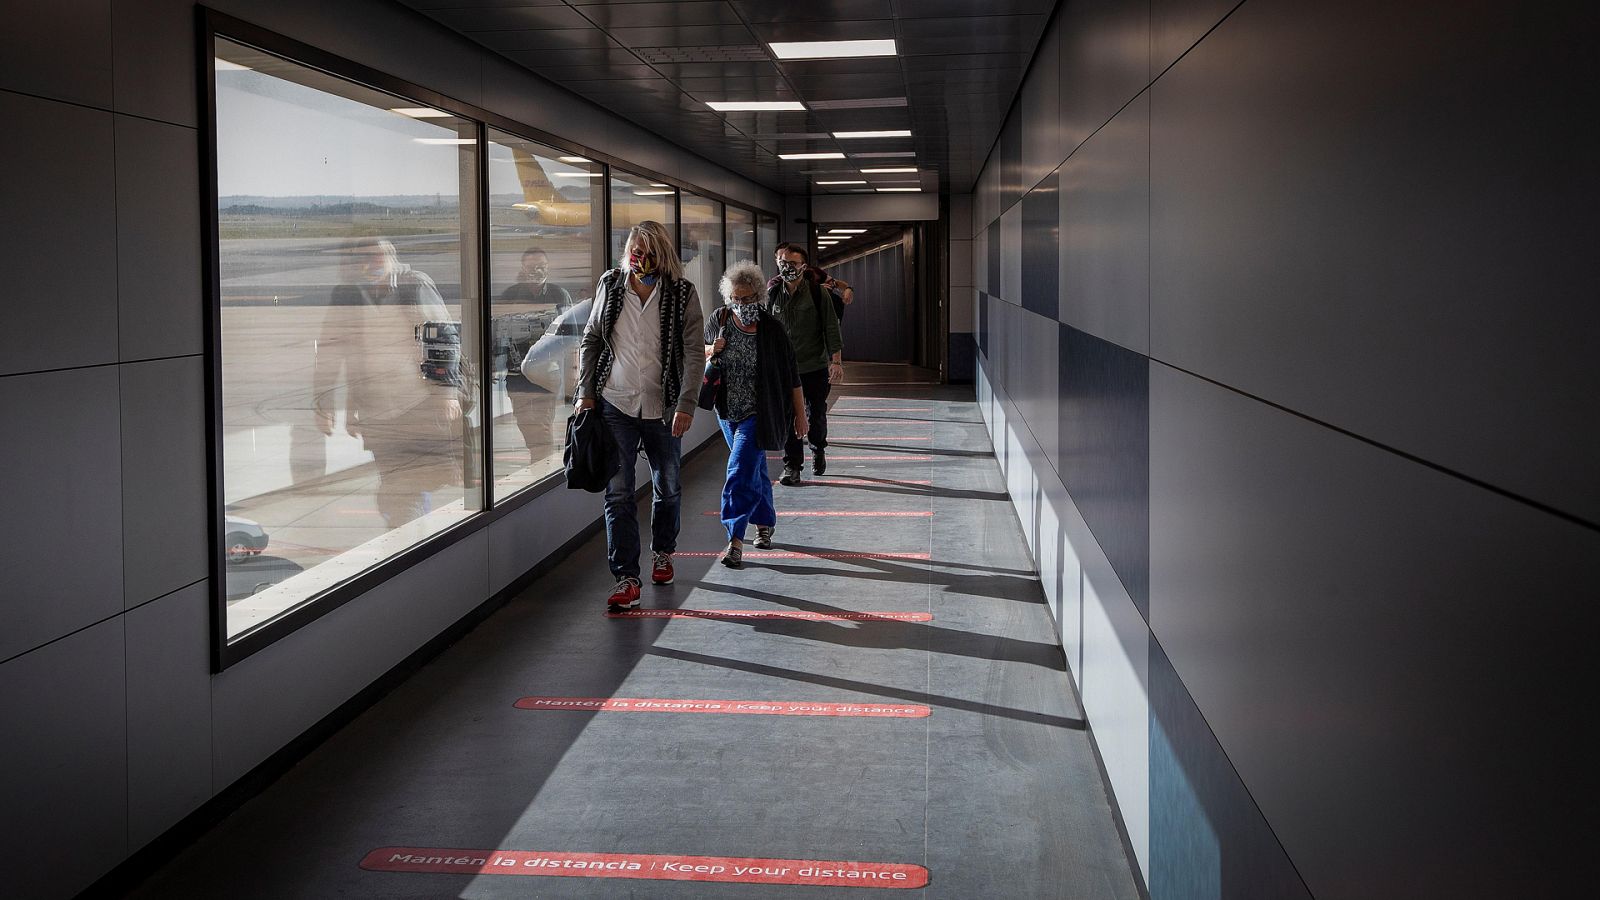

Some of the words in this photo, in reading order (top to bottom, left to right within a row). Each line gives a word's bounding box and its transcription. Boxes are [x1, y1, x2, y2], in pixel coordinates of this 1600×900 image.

[634, 701, 721, 709] distancia
[736, 703, 783, 712] Keep
[836, 706, 915, 714] distance
[388, 853, 486, 866] Mantén
[492, 856, 517, 867] la
[523, 857, 642, 871] distancia
[662, 862, 725, 875] Keep
[731, 866, 791, 877] your
[798, 867, 907, 880] distance
